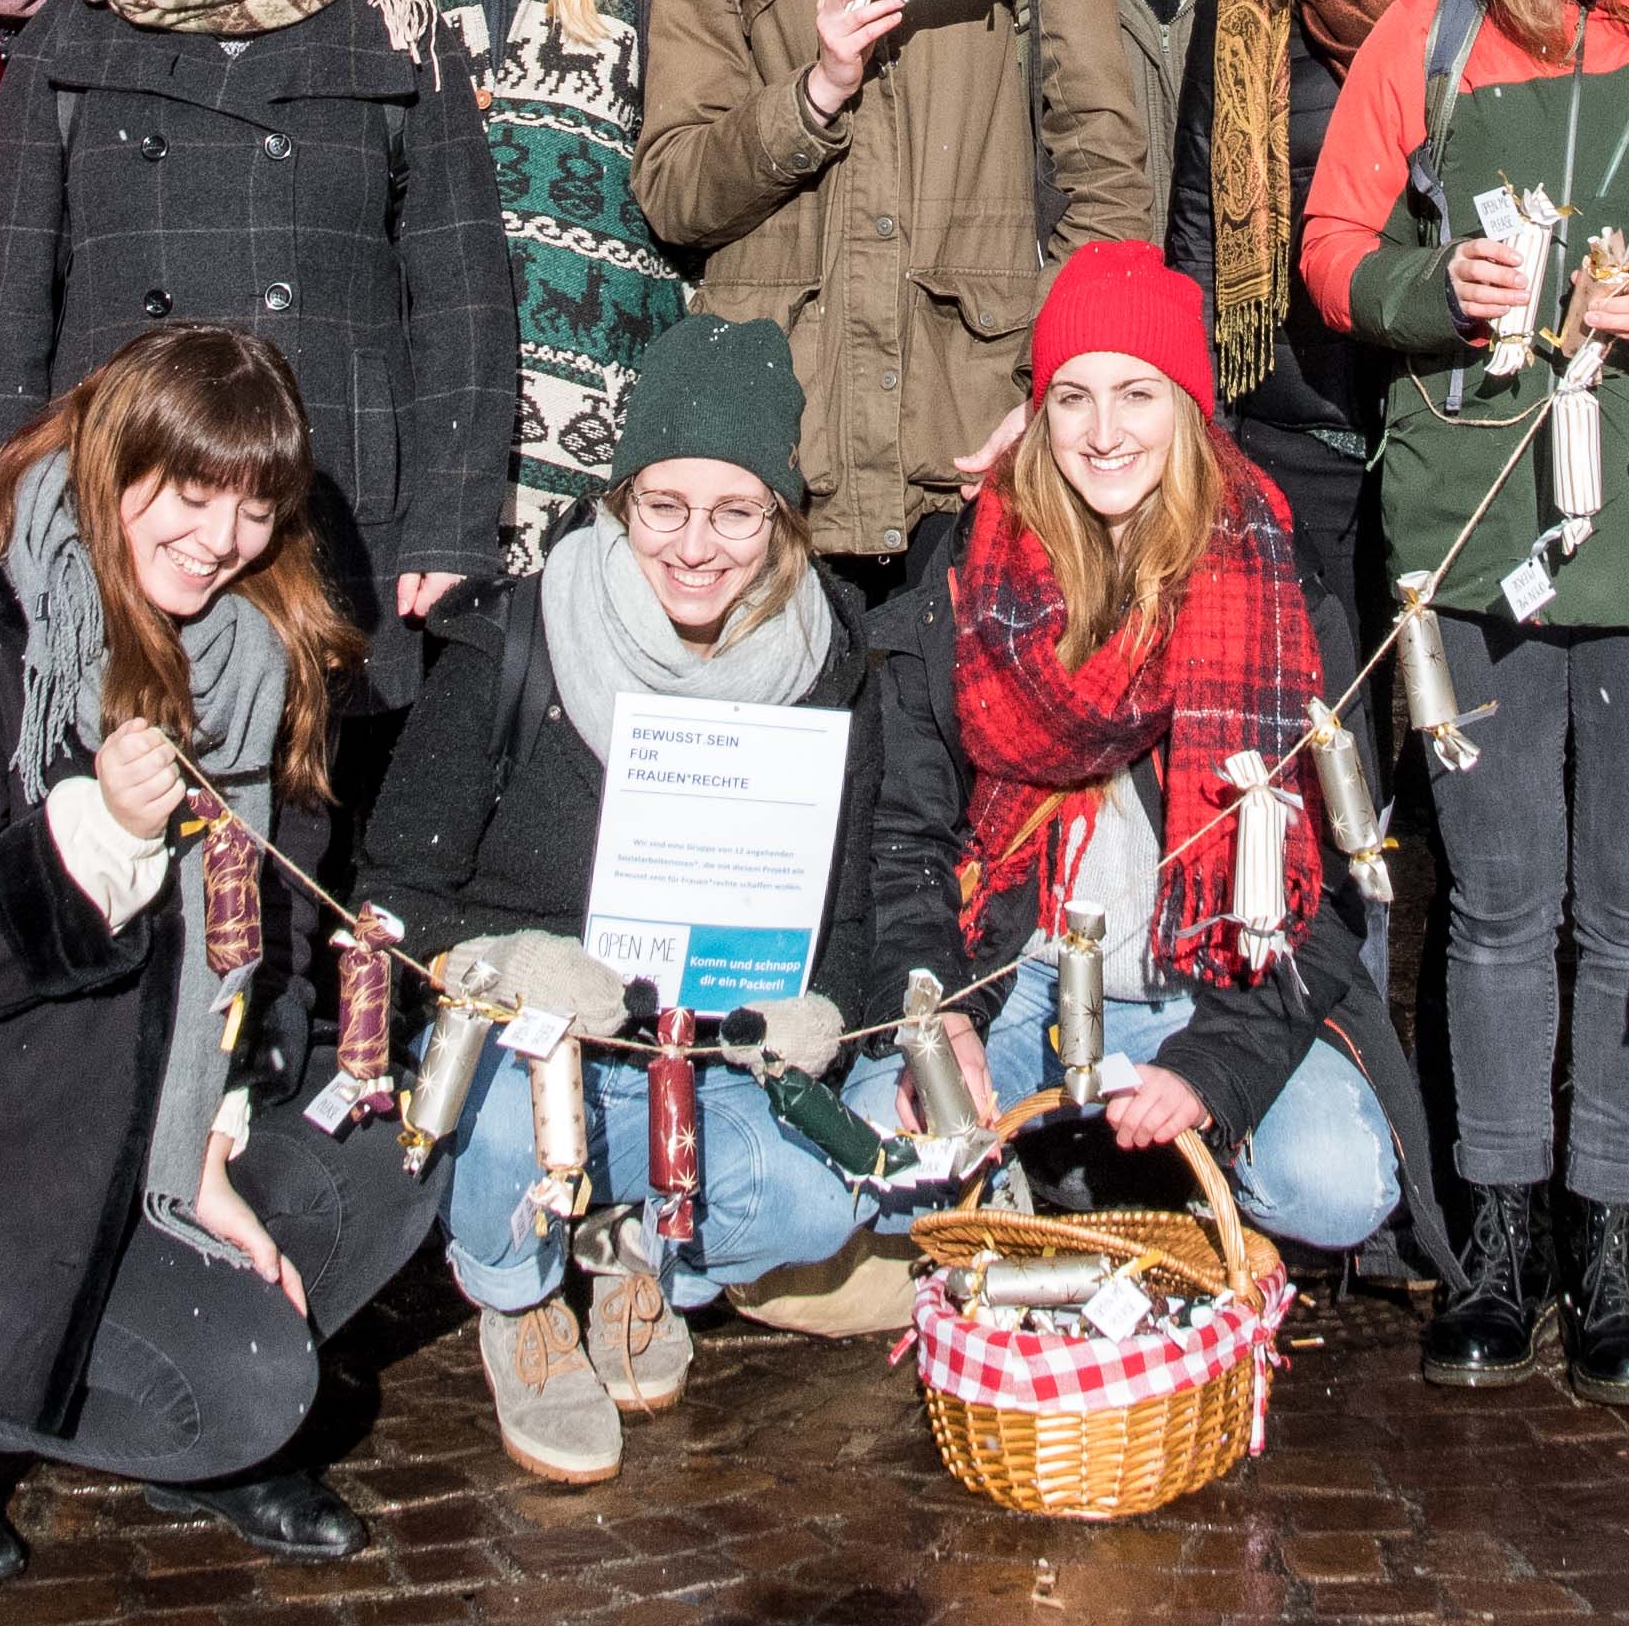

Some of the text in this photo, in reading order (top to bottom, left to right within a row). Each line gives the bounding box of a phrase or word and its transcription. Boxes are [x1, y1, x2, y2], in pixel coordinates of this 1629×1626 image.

[629, 746, 659, 762] FÜR
[598, 931, 802, 975] OPEN ME Komm und schnapp
[699, 973, 718, 987] dir
[718, 975, 737, 989] ein
